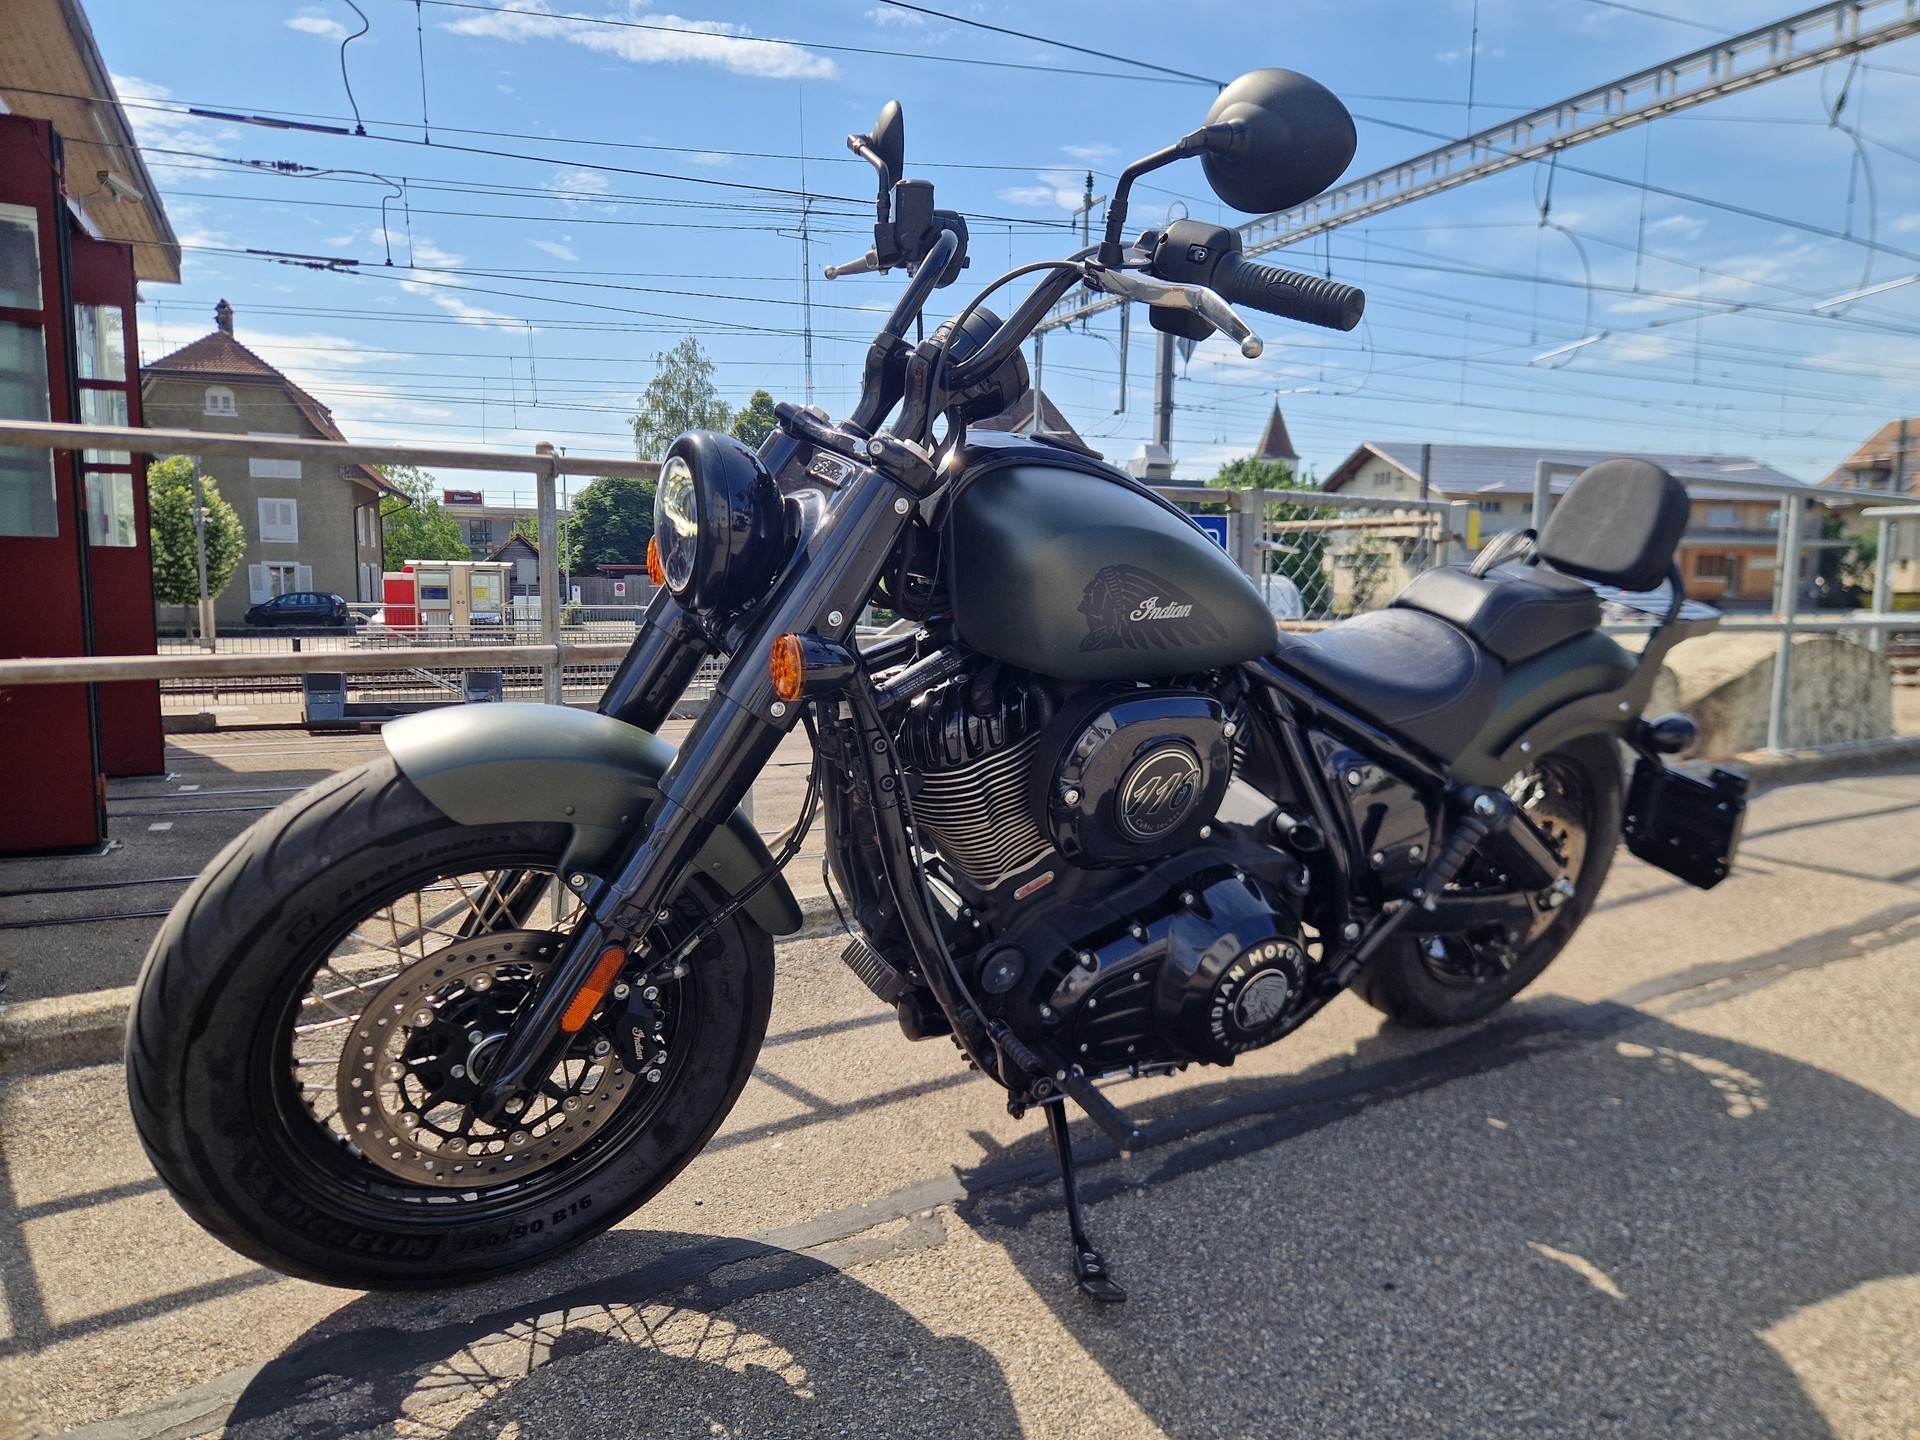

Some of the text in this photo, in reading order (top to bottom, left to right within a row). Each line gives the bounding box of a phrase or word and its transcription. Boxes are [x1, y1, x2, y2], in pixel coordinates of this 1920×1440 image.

[1130, 596, 1192, 622] Indian
[1124, 768, 1200, 817] 116
[1211, 964, 1246, 1040] INDIAN
[631, 1026, 646, 1060] Indian
[552, 1194, 593, 1225] B16
